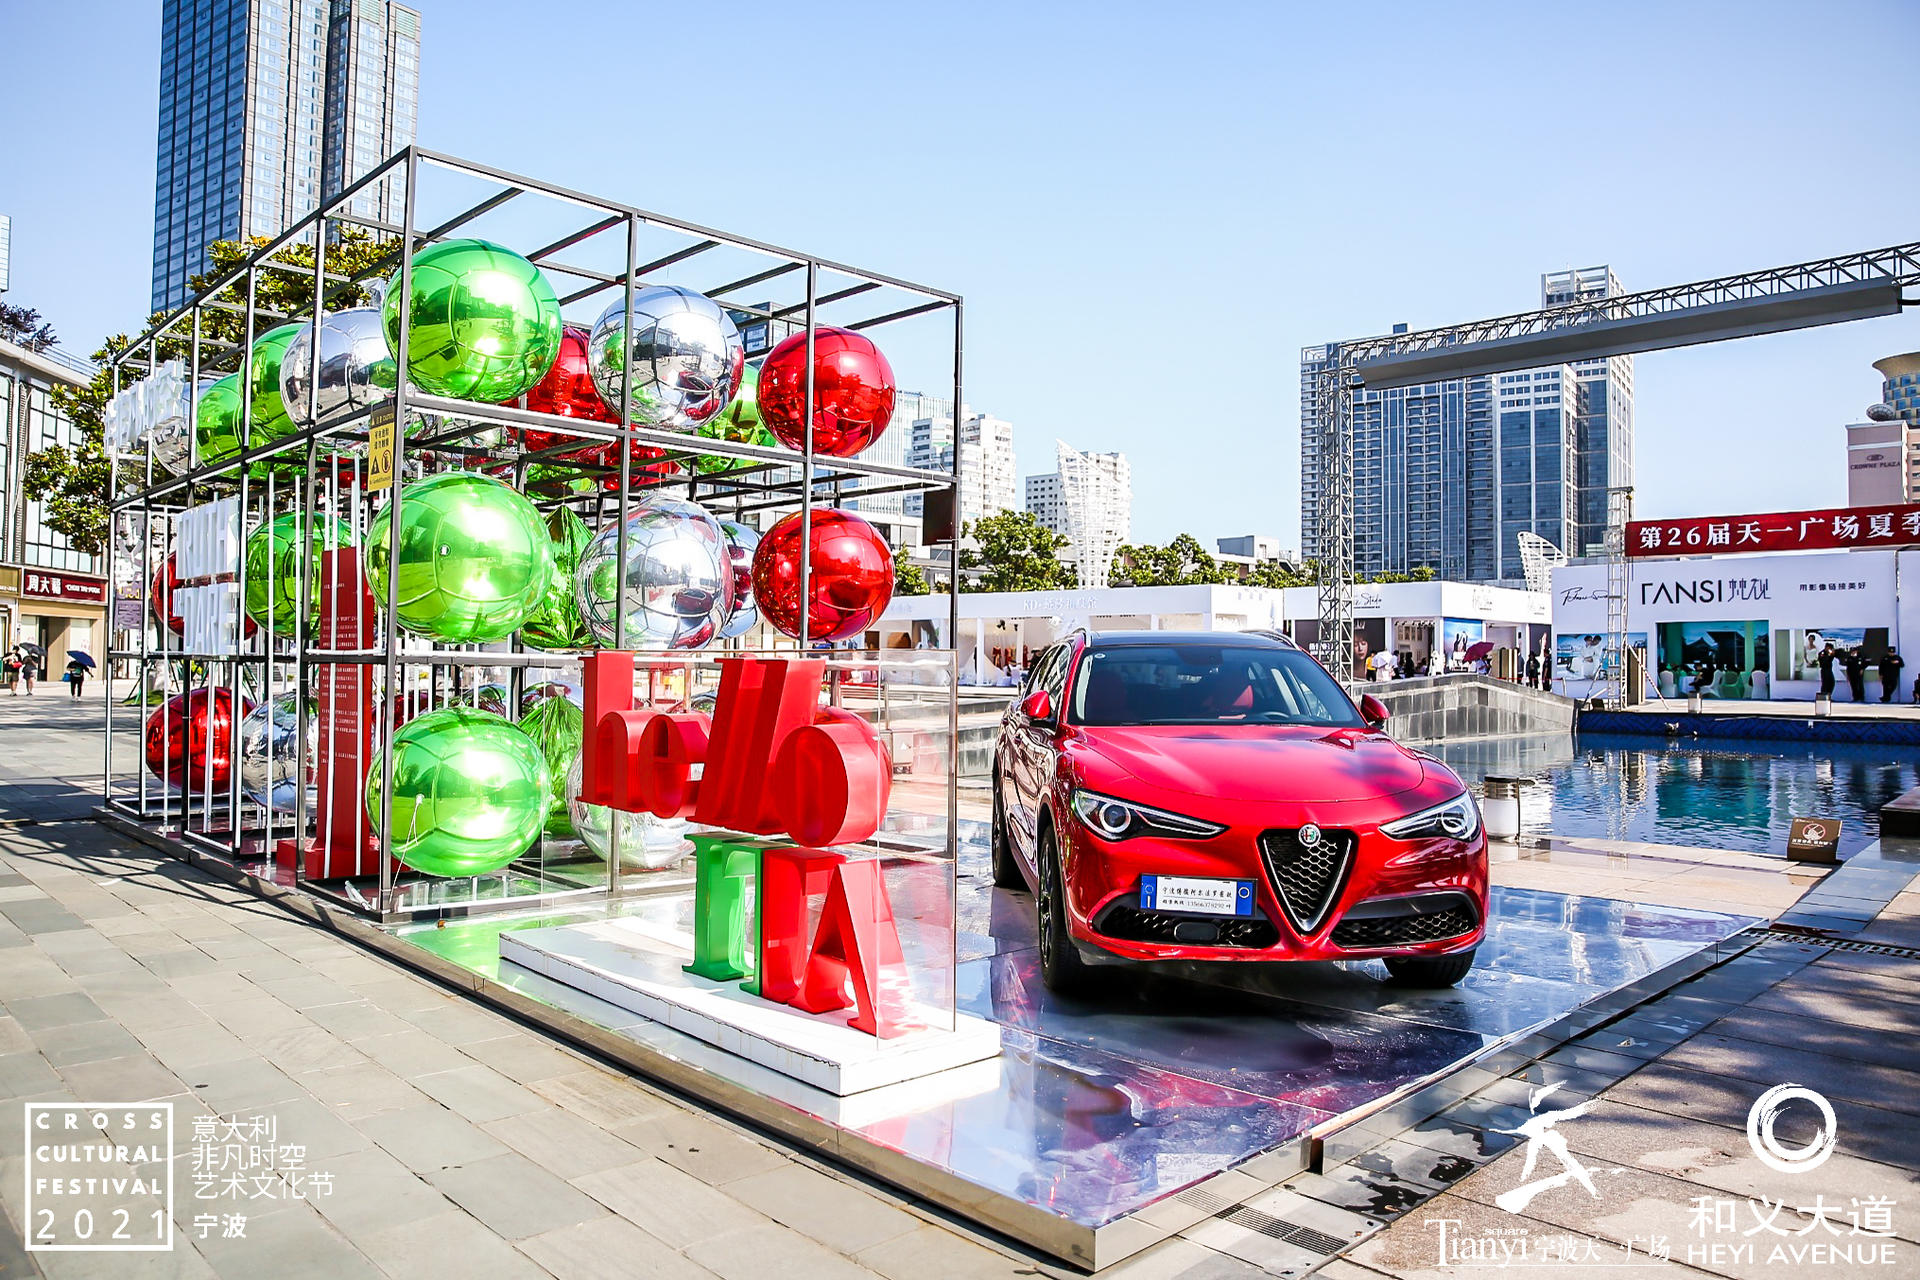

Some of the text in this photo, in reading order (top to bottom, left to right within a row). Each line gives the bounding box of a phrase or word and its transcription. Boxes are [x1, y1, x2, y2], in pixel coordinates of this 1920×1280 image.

[1799, 581, 1866, 592] 用影像链接美好
